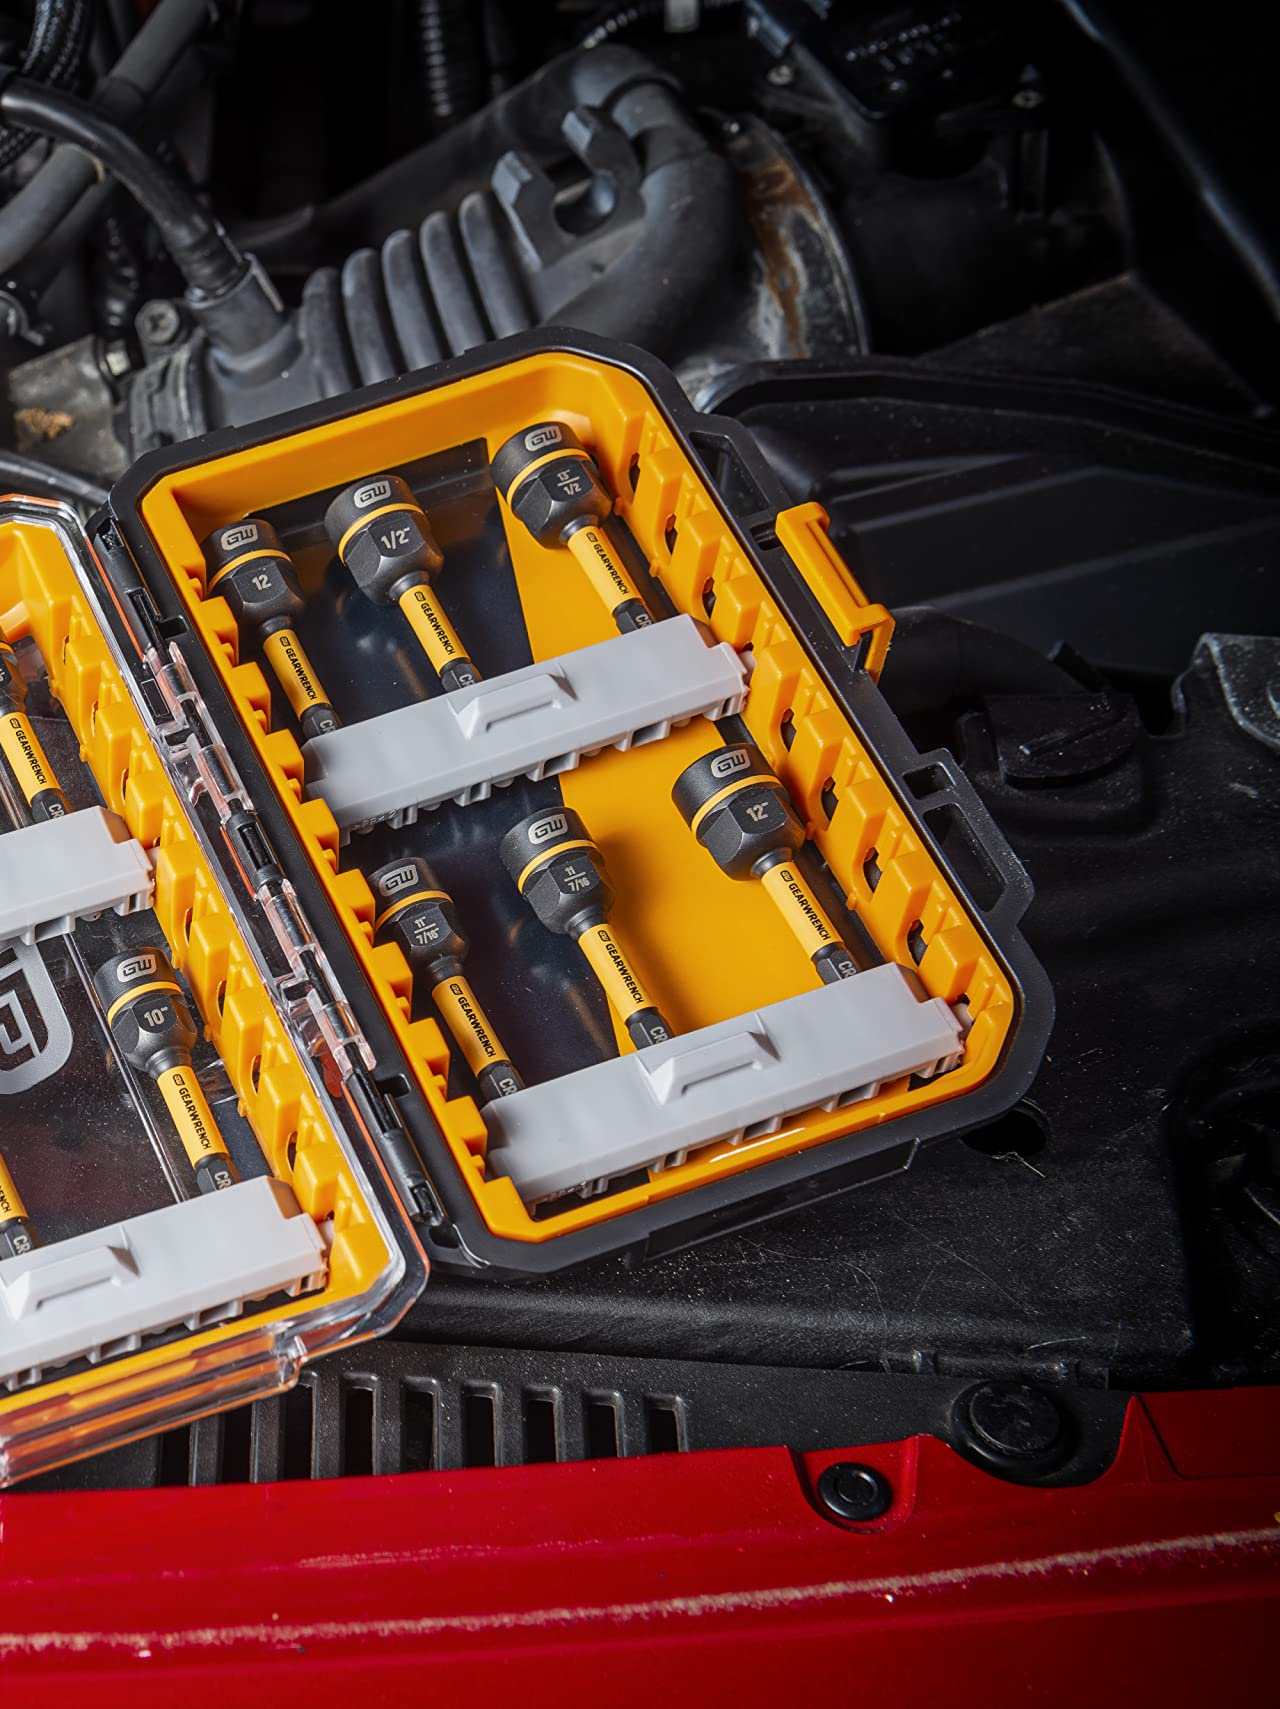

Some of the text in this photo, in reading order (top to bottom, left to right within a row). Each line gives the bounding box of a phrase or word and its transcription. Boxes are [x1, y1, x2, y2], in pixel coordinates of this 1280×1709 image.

[563, 483, 582, 495] 1/2
[252, 574, 272, 590] 12
[593, 544, 629, 594] GEARWRENCH
[421, 602, 455, 654] GEARWRENCH
[286, 648, 317, 699] GEARWRENCH
[15, 729, 47, 784] GEARWRENCH
[565, 866, 575, 875] 11
[567, 877, 590, 891] 7/16
[788, 883, 829, 941] GEARWRENCH
[606, 943, 644, 1003] GEARWRENCH
[458, 997, 494, 1057] GEARWRENCH
[179, 1088, 211, 1149] GEARWRENCH
